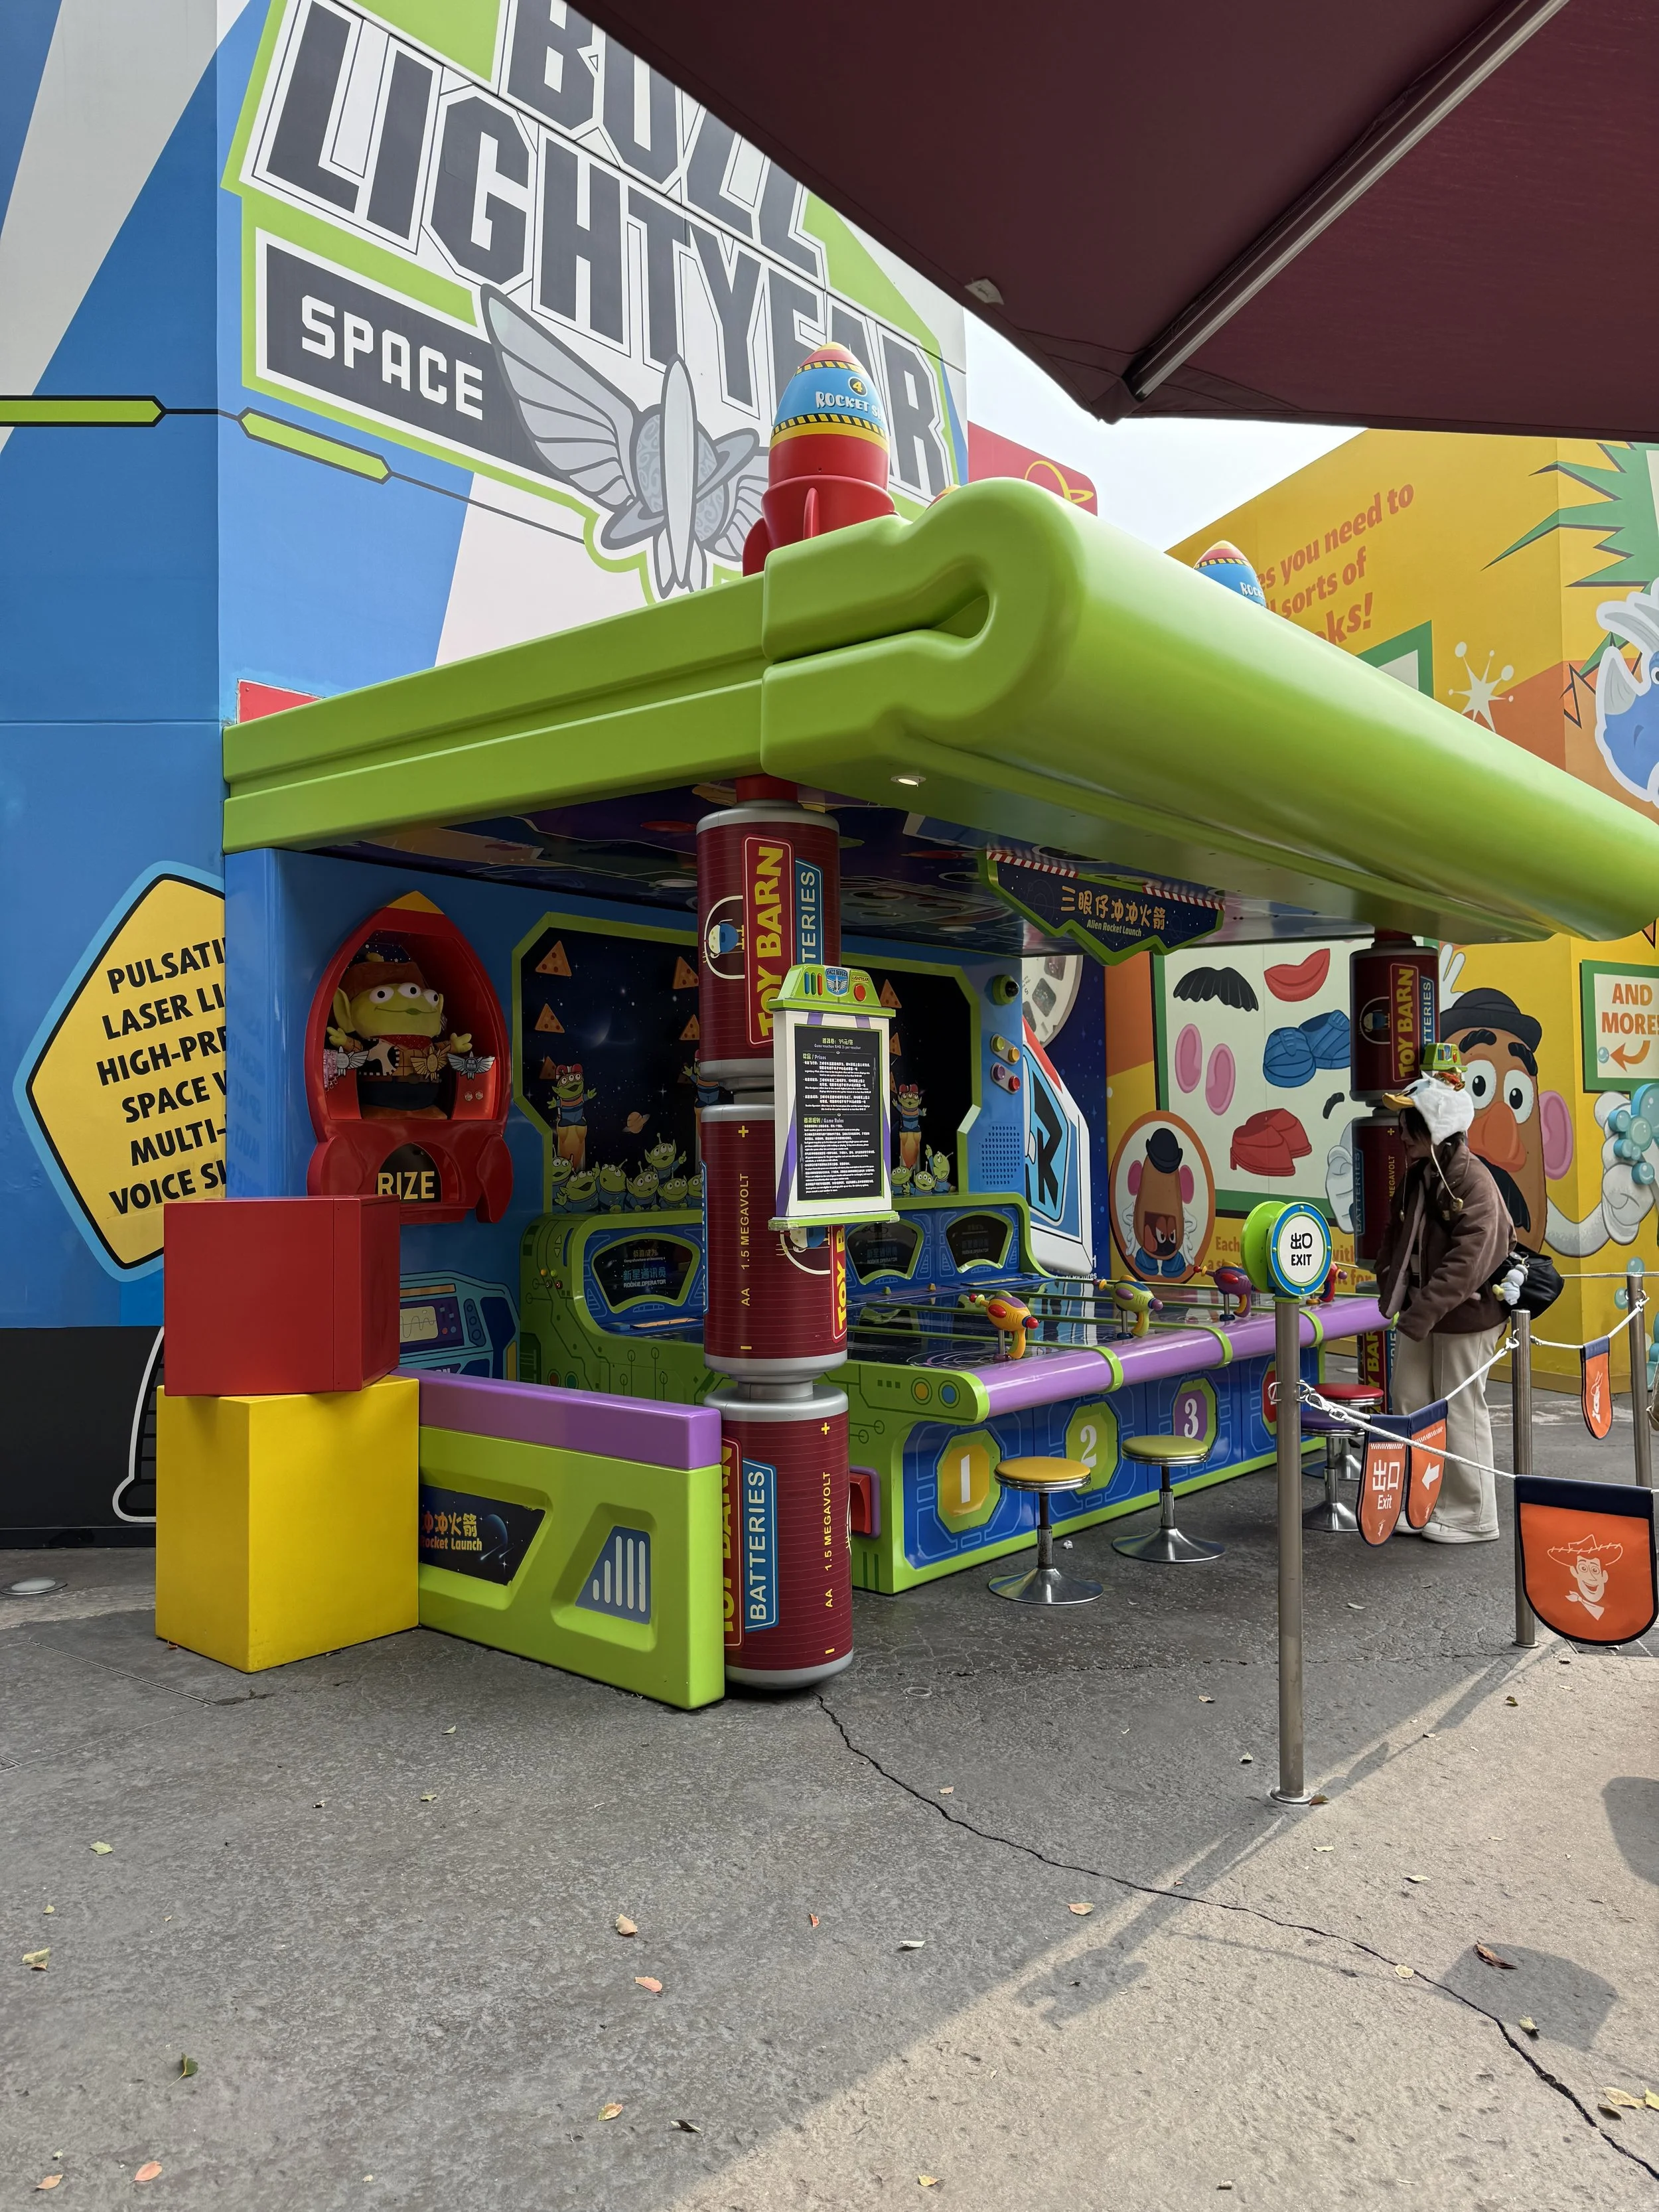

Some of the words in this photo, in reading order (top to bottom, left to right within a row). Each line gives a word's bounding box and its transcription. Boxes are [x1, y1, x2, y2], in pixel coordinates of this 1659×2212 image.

[301, 295, 485, 422] SPACE
[816, 392, 869, 413] ROCKET
[853, 381, 863, 393] 4
[1280, 539, 1321, 586] you
[1325, 492, 1382, 554] need
[1387, 484, 1414, 515] to
[1281, 572, 1338, 619] sorts
[1342, 546, 1366, 585] of
[755, 847, 784, 958] BARN
[1060, 885, 1166, 930] 三眼仔冲冲火箭
[1086, 919, 1102, 930] Alien
[1102, 922, 1121, 934] Rocket
[1123, 924, 1142, 937] Launch
[107, 937, 226, 994] PULSATI
[757, 966, 782, 1037] TOY
[1396, 968, 1414, 1033] BARN
[1612, 984, 1653, 1006] AND
[102, 994, 194, 1041] LASER
[1398, 1036, 1415, 1078] TOY
[121, 1076, 210, 1124] SPACE
[109, 1169, 196, 1215] VOICE
[740, 1173, 749, 1246] MEGAVOLT
[741, 1250, 750, 1270] 1.5
[1216, 1236, 1240, 1252] Each
[1291, 1232, 1313, 1249] 出口
[1291, 1254, 1312, 1266] EXIT
[623, 1266, 666, 1281] 新星通讯员
[741, 1288, 751, 1307] AA
[837, 1260, 846, 1331] TOY
[1184, 1398, 1198, 1438] 3
[1080, 1425, 1097, 1468] 2
[961, 1455, 970, 1504] 1
[1372, 1459, 1400, 1491] 出口
[823, 1471, 833, 1546] MEGAVOLT
[1377, 1494, 1393, 1510] Exit
[451, 1538, 482, 1551] Launch
[749, 1471, 766, 1620] BATTERIES
[825, 1588, 833, 1608] AA
